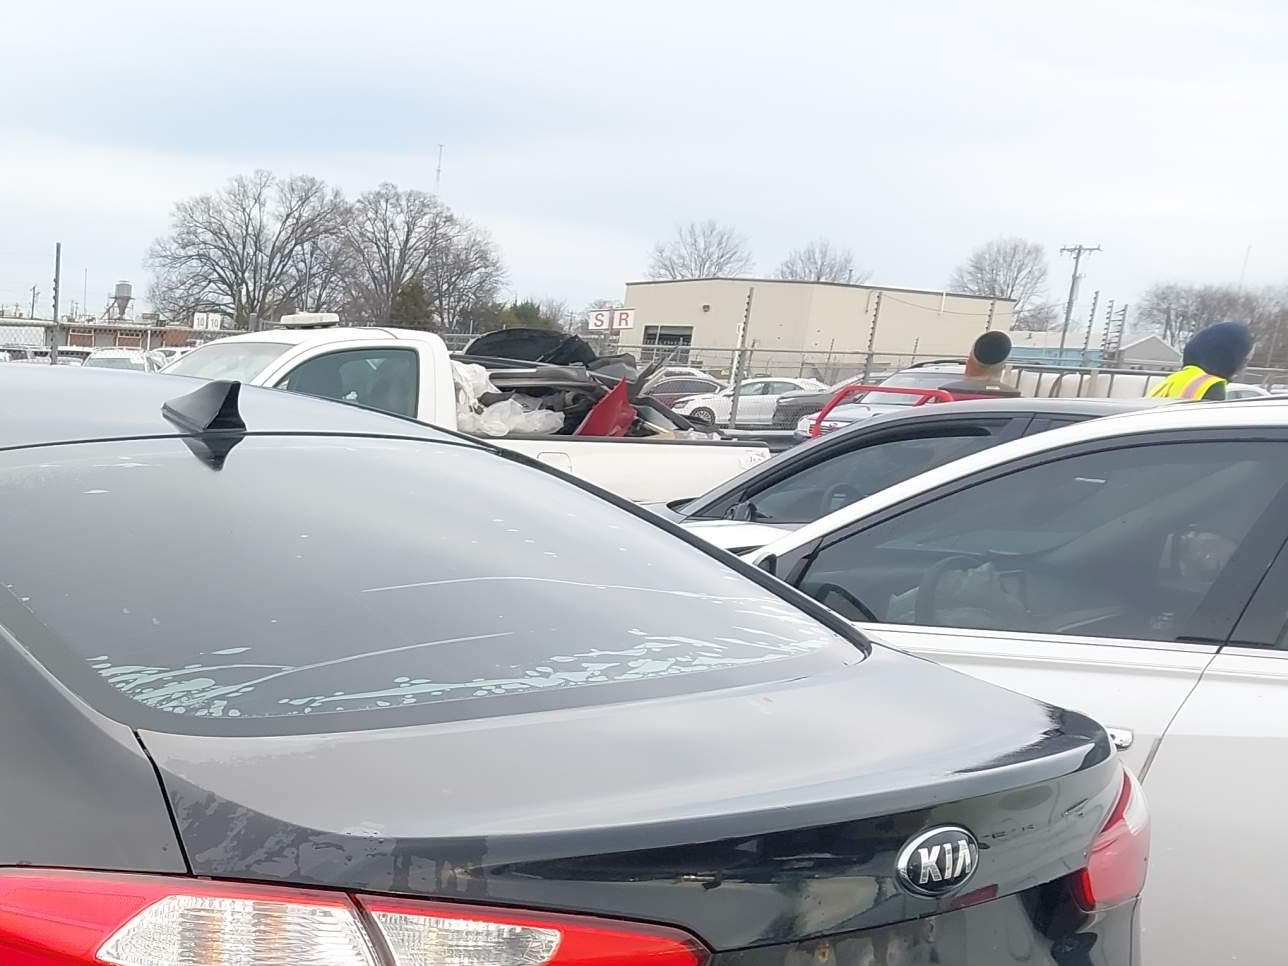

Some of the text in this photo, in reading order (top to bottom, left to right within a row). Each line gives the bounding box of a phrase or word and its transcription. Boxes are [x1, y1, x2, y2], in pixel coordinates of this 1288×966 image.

[593, 312, 630, 328] S R
[918, 839, 972, 884] KIA
